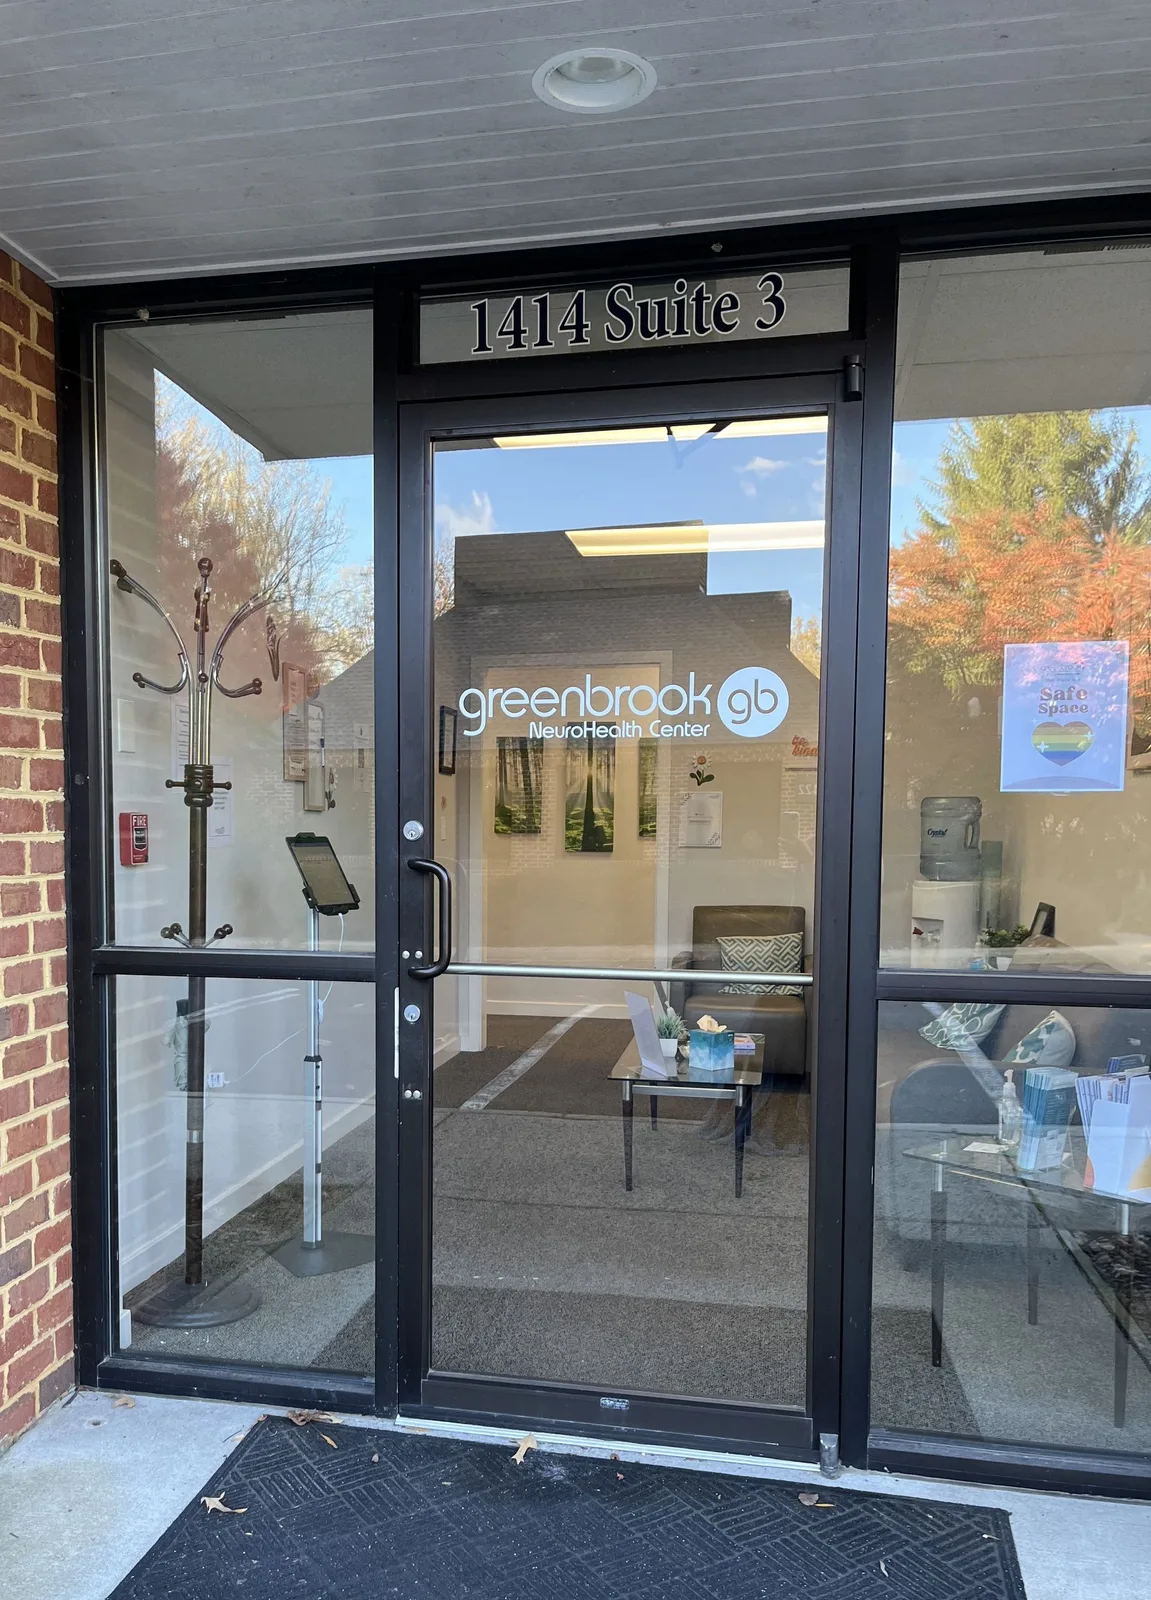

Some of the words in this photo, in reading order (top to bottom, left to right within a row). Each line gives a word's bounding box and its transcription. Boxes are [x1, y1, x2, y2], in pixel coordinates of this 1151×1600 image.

[470, 289, 591, 355] 1414
[604, 278, 740, 344] Suite
[754, 271, 787, 332] 3
[1040, 685, 1088, 701] Safe
[458, 671, 713, 737] greenbrook
[727, 678, 779, 725] gb
[1038, 702, 1089, 717] Space
[529, 720, 642, 740] NeuroHealth
[649, 719, 711, 738] Center
[132, 815, 147, 827] FIRE
